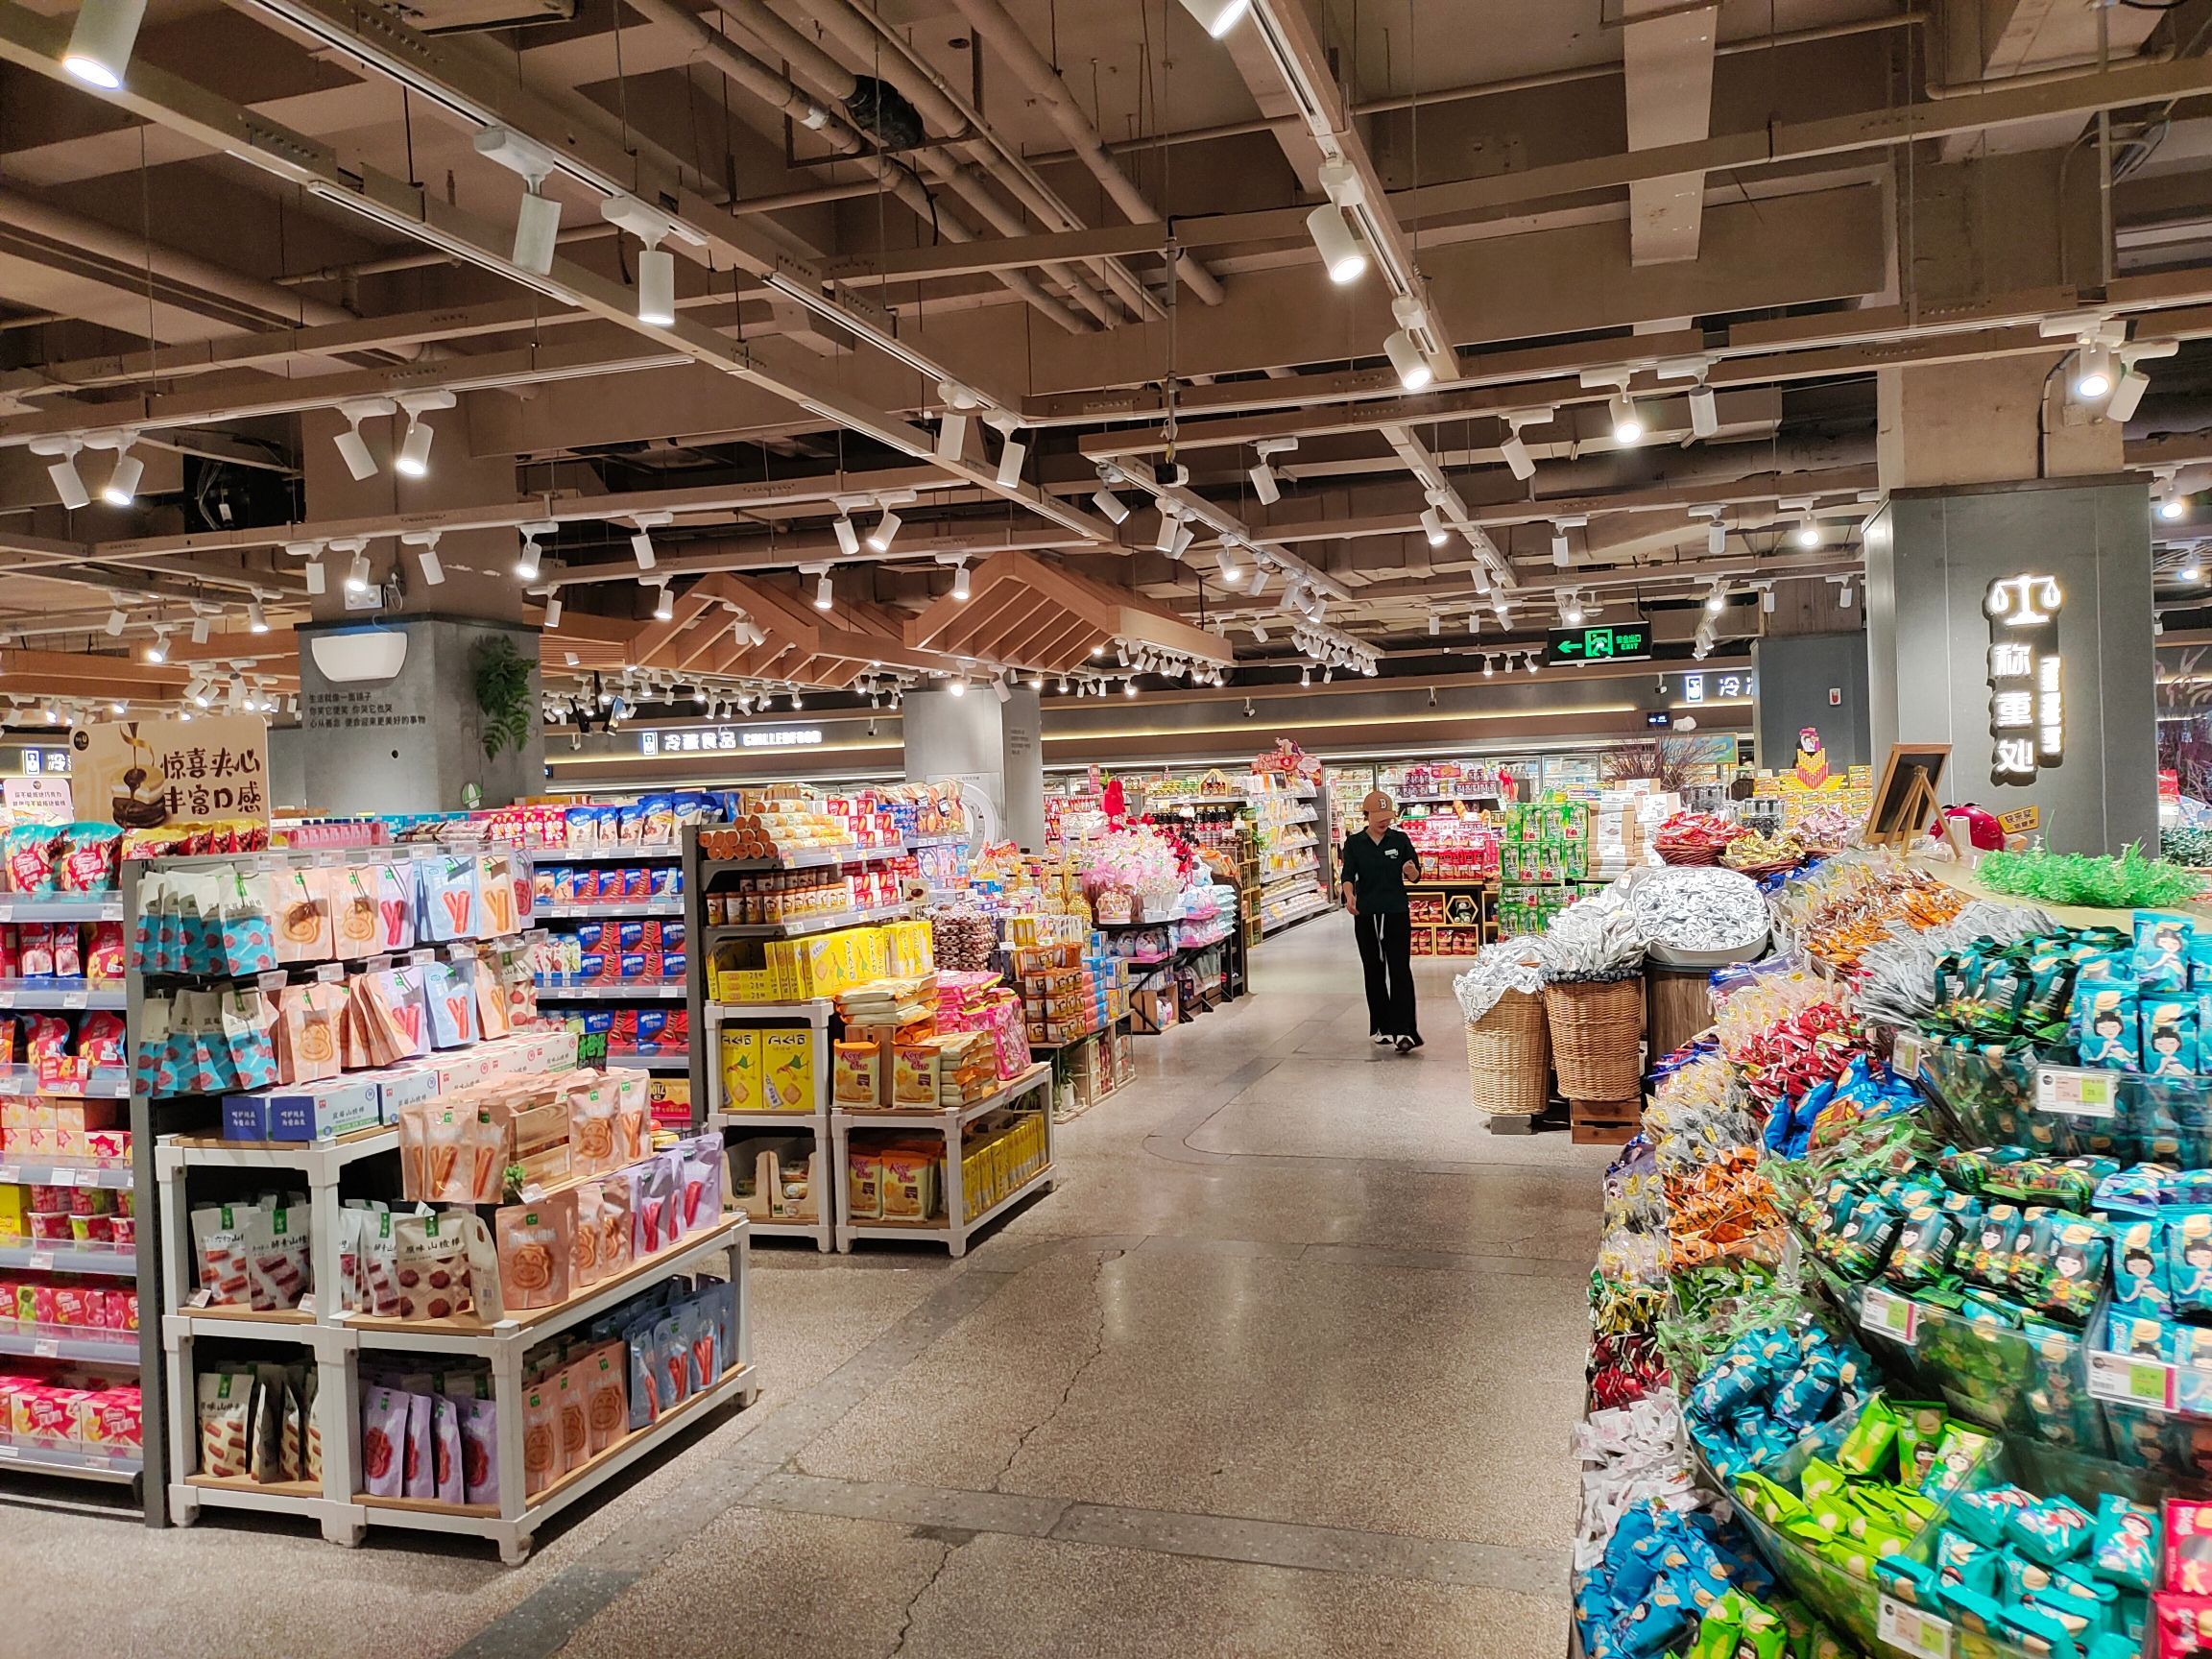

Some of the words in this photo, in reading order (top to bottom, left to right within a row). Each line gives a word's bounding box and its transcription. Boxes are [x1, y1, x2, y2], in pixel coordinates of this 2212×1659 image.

[1994, 643, 2035, 772] 称重处
[160, 748, 261, 779] 惊喜夹心
[164, 781, 262, 816] 丰富口感
[1379, 798, 1388, 810] B
